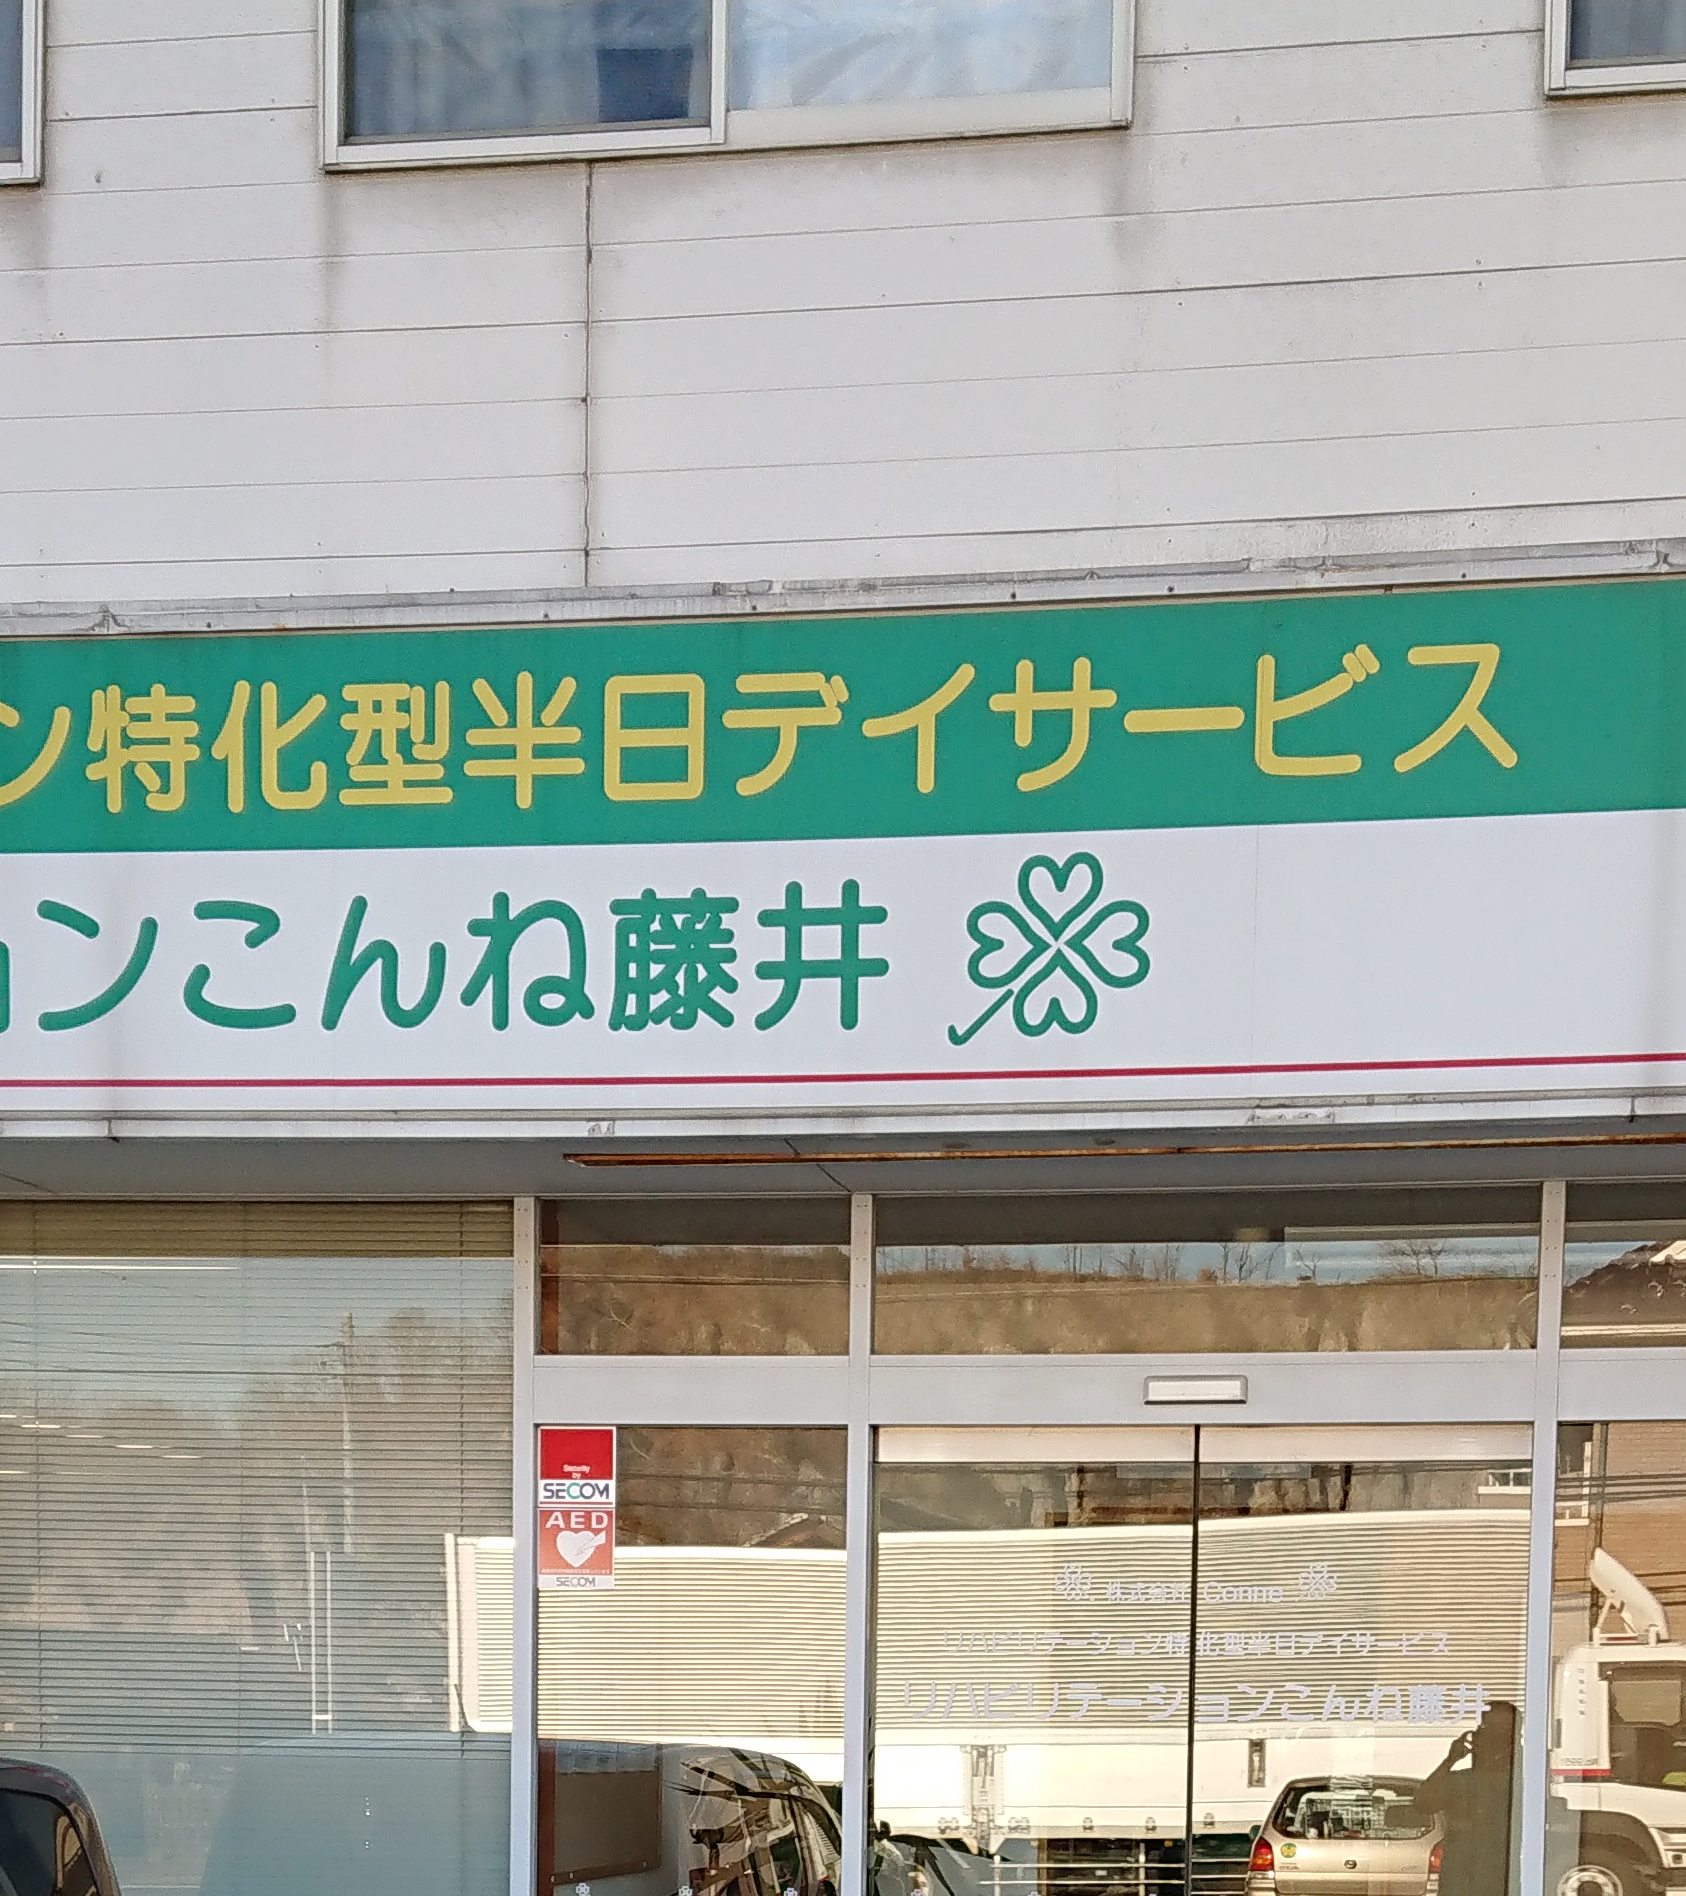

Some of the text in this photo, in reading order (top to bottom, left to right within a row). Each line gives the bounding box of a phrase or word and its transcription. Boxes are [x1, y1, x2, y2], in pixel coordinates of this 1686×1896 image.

[543, 1482, 609, 1499] SECOM
[545, 1511, 608, 1529] AED
[555, 1576, 596, 1588] SECOM
[1106, 1580, 1285, 1603] 株式会社 Conne
[903, 1680, 1491, 1724] リハビリテーションこんね藤井
